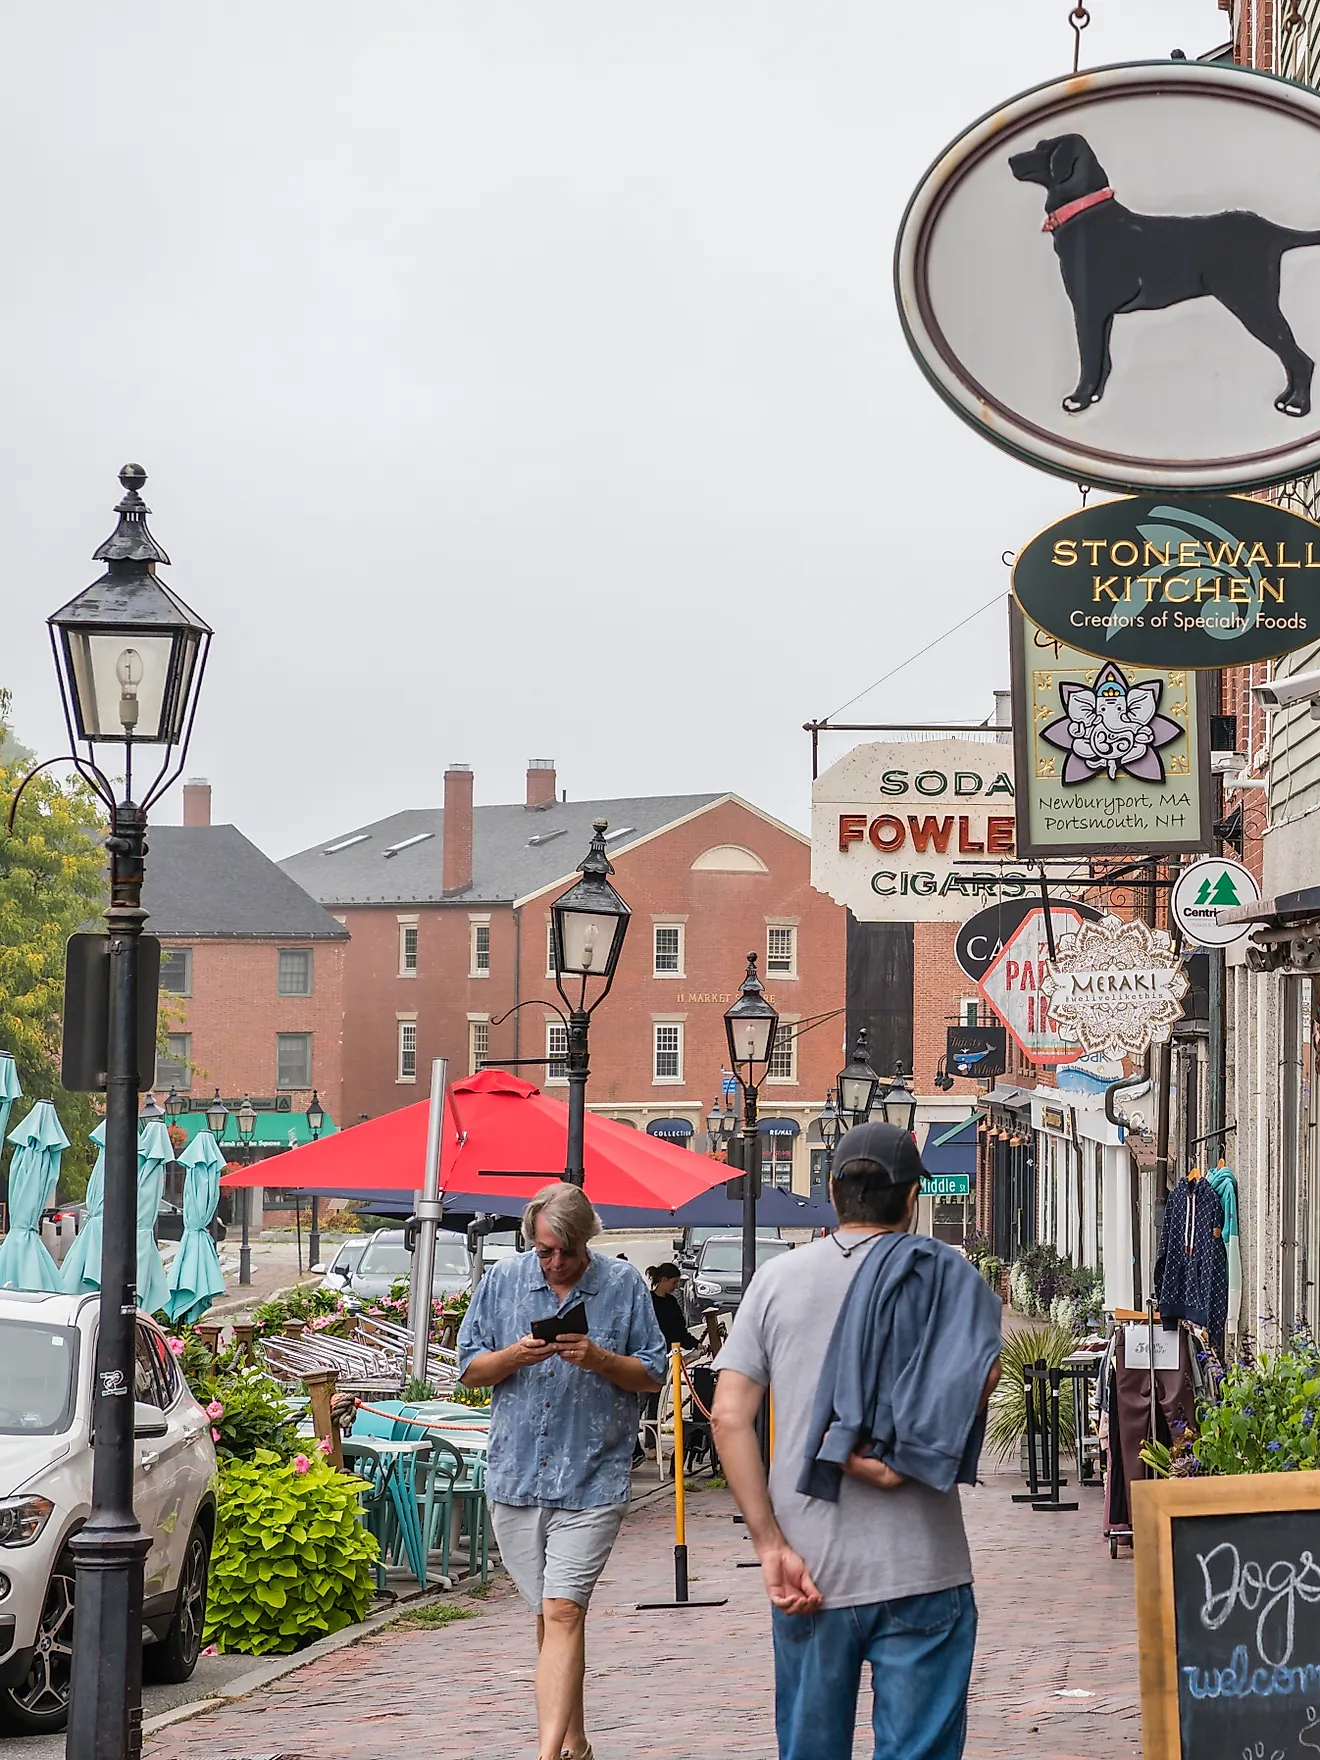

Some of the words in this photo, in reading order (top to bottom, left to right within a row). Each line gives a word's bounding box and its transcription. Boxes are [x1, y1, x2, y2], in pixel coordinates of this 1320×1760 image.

[1091, 575, 1285, 603] KITCHEN
[1069, 610, 1145, 628] Creators
[1151, 610, 1168, 627] of
[1174, 610, 1250, 632] Specialty
[1256, 611, 1307, 629] Foods
[880, 770, 1014, 797] SODA
[1039, 794, 1153, 816] Newburyport,
[1159, 793, 1191, 807] MA
[838, 814, 1015, 853] FOWLE
[1045, 814, 1149, 831] Portsmouth,
[1155, 814, 1186, 828] NH
[871, 871, 1026, 896] CIGARS
[1071, 973, 1156, 995] MERAKI
[688, 993, 731, 1003] MARKET
[735, 993, 776, 1003] SRE
[919, 1178, 956, 1193] Middle
